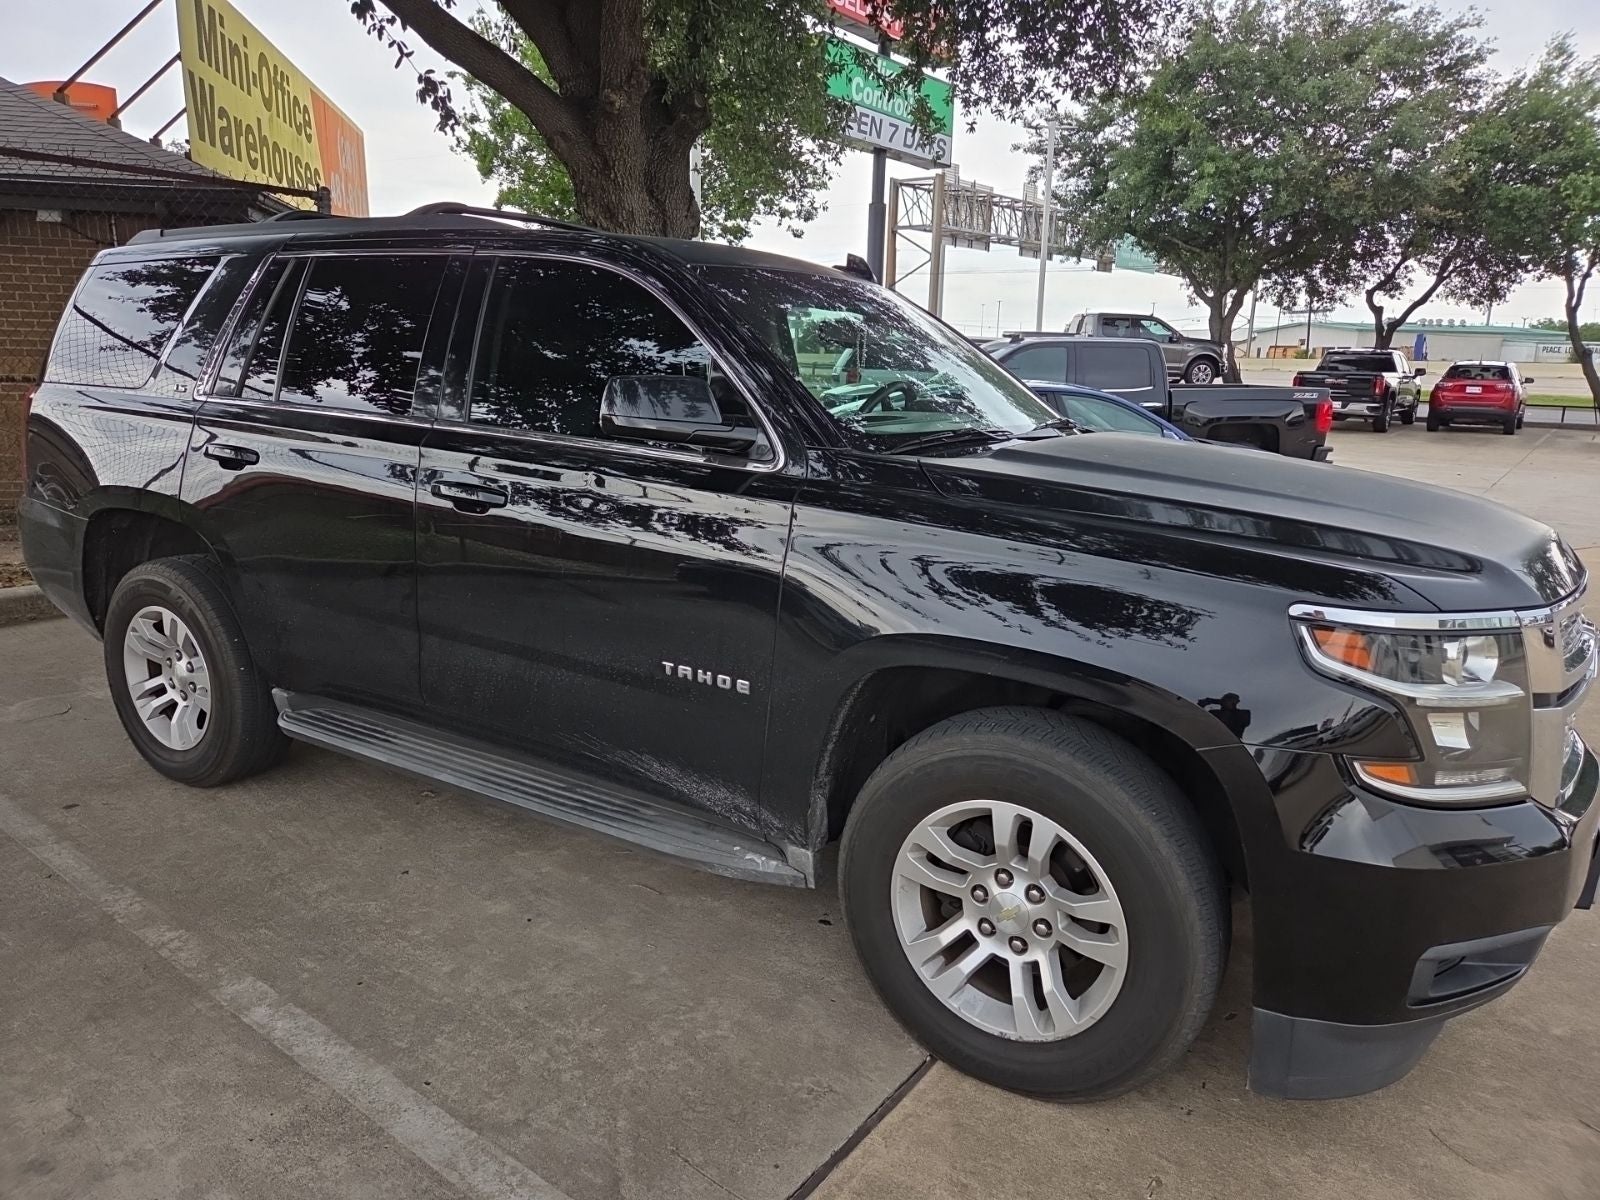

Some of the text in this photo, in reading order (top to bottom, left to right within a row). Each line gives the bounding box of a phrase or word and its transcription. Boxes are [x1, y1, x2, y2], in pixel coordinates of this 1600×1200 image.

[194, 0, 313, 144] Mini-Office
[187, 69, 321, 191] Warehouses
[888, 122, 899, 143] 7
[661, 661, 750, 695] TAHOE
